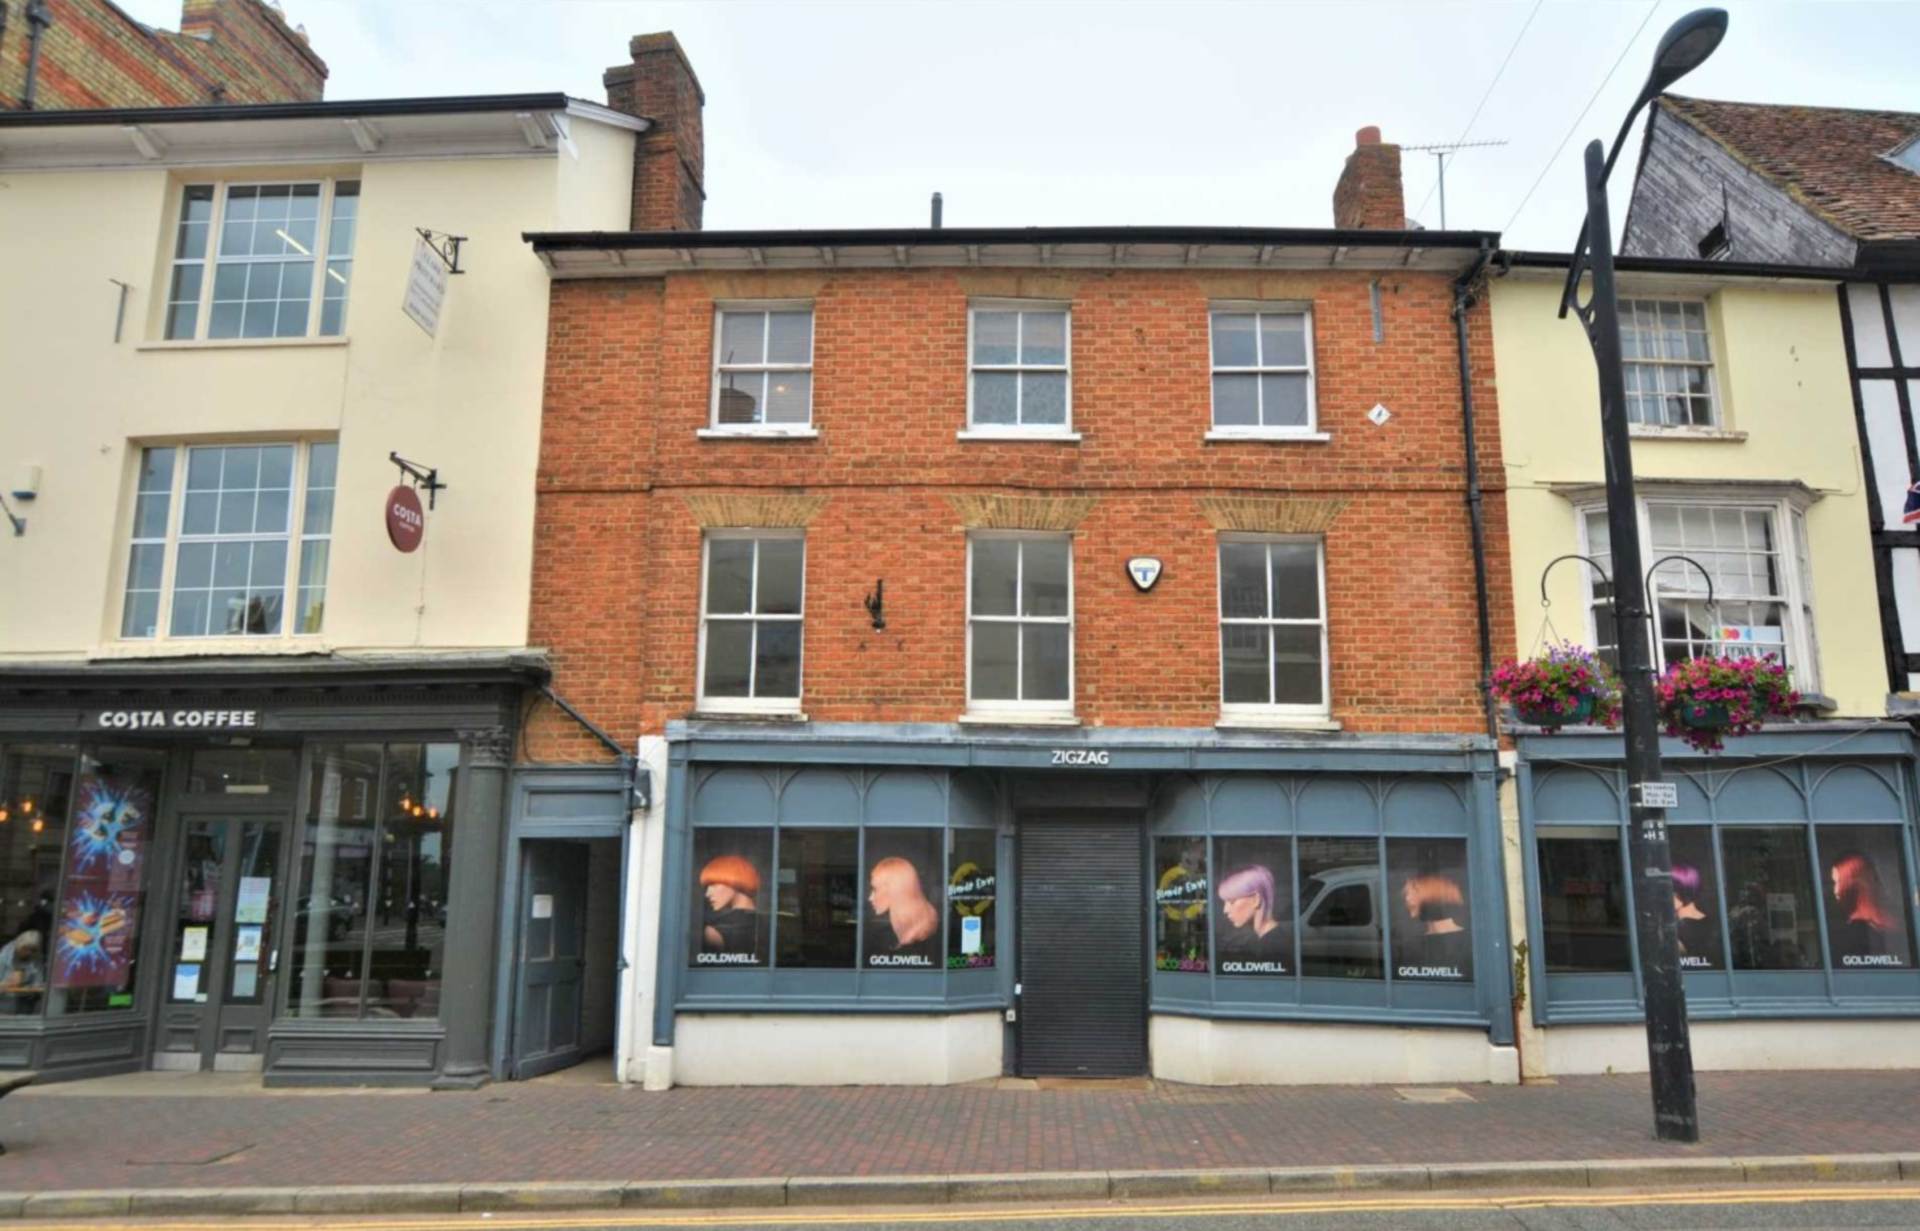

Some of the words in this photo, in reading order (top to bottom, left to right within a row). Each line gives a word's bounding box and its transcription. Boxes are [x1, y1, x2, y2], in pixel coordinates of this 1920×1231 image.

[393, 503, 422, 527] COSTA
[99, 711, 165, 729] COSTA
[172, 710, 256, 727] COFFEE
[1051, 750, 1109, 764] ZIGZAG
[697, 952, 759, 964] GOLDWELL
[870, 955, 932, 966] GOLDWELL
[1680, 956, 1711, 967] WELL
[1842, 955, 1903, 966] GOLDWELL
[1222, 961, 1286, 973] GOLDWELL
[1398, 966, 1462, 978] GOLDWELL
